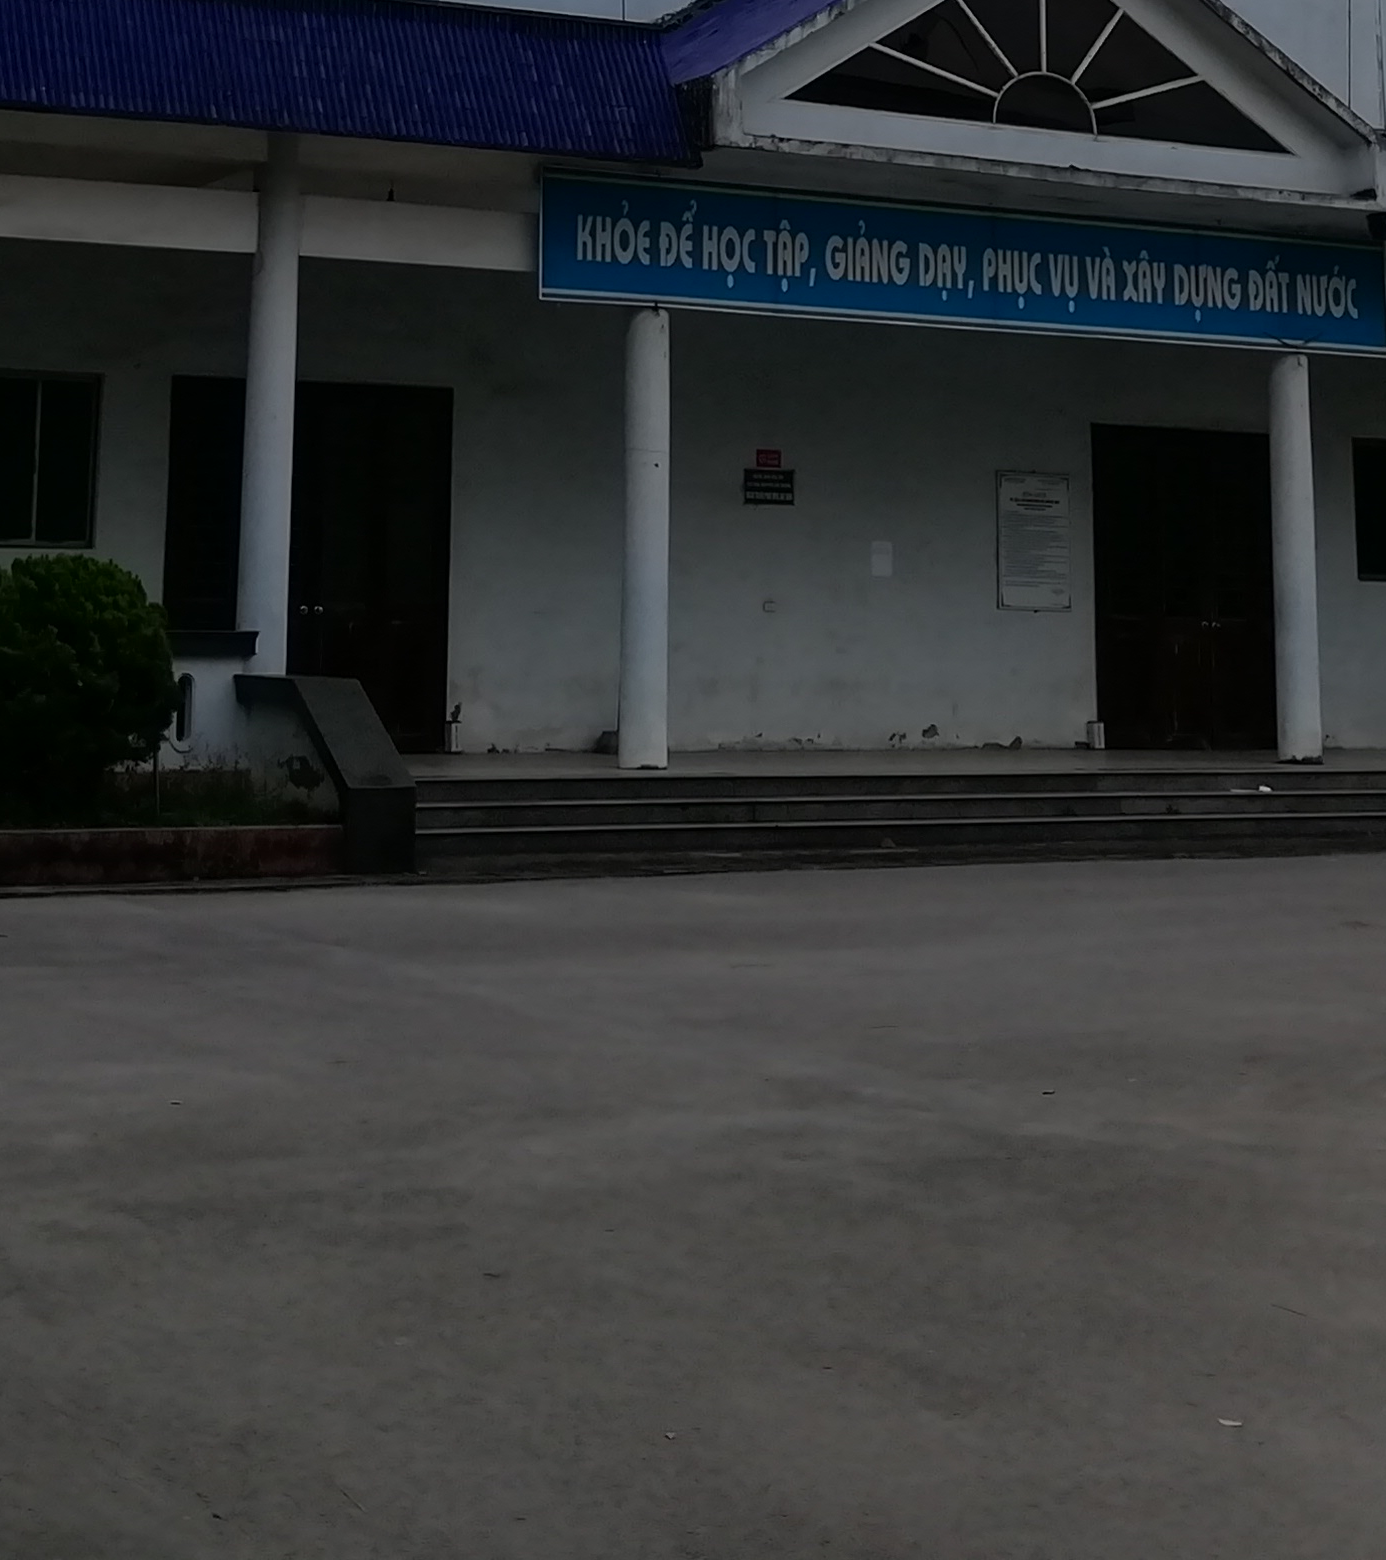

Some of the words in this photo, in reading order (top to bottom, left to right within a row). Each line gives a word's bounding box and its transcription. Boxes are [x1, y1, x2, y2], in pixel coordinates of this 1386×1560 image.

[576, 199, 651, 265] KHỎE
[659, 199, 698, 269] ĐỂ
[702, 224, 756, 289] HỌC
[763, 218, 817, 293] TẬP,
[824, 219, 911, 286] GIẢNG
[918, 242, 975, 301] DẠY,
[982, 247, 1043, 310] PHỤC
[1047, 252, 1080, 313] VỤ
[1085, 246, 1116, 301] VÀ
[1121, 249, 1166, 305] XÂY
[1173, 262, 1242, 323] DỰNG
[1248, 254, 1290, 314] ĐẤT
[1296, 264, 1359, 320] NƯỚC
